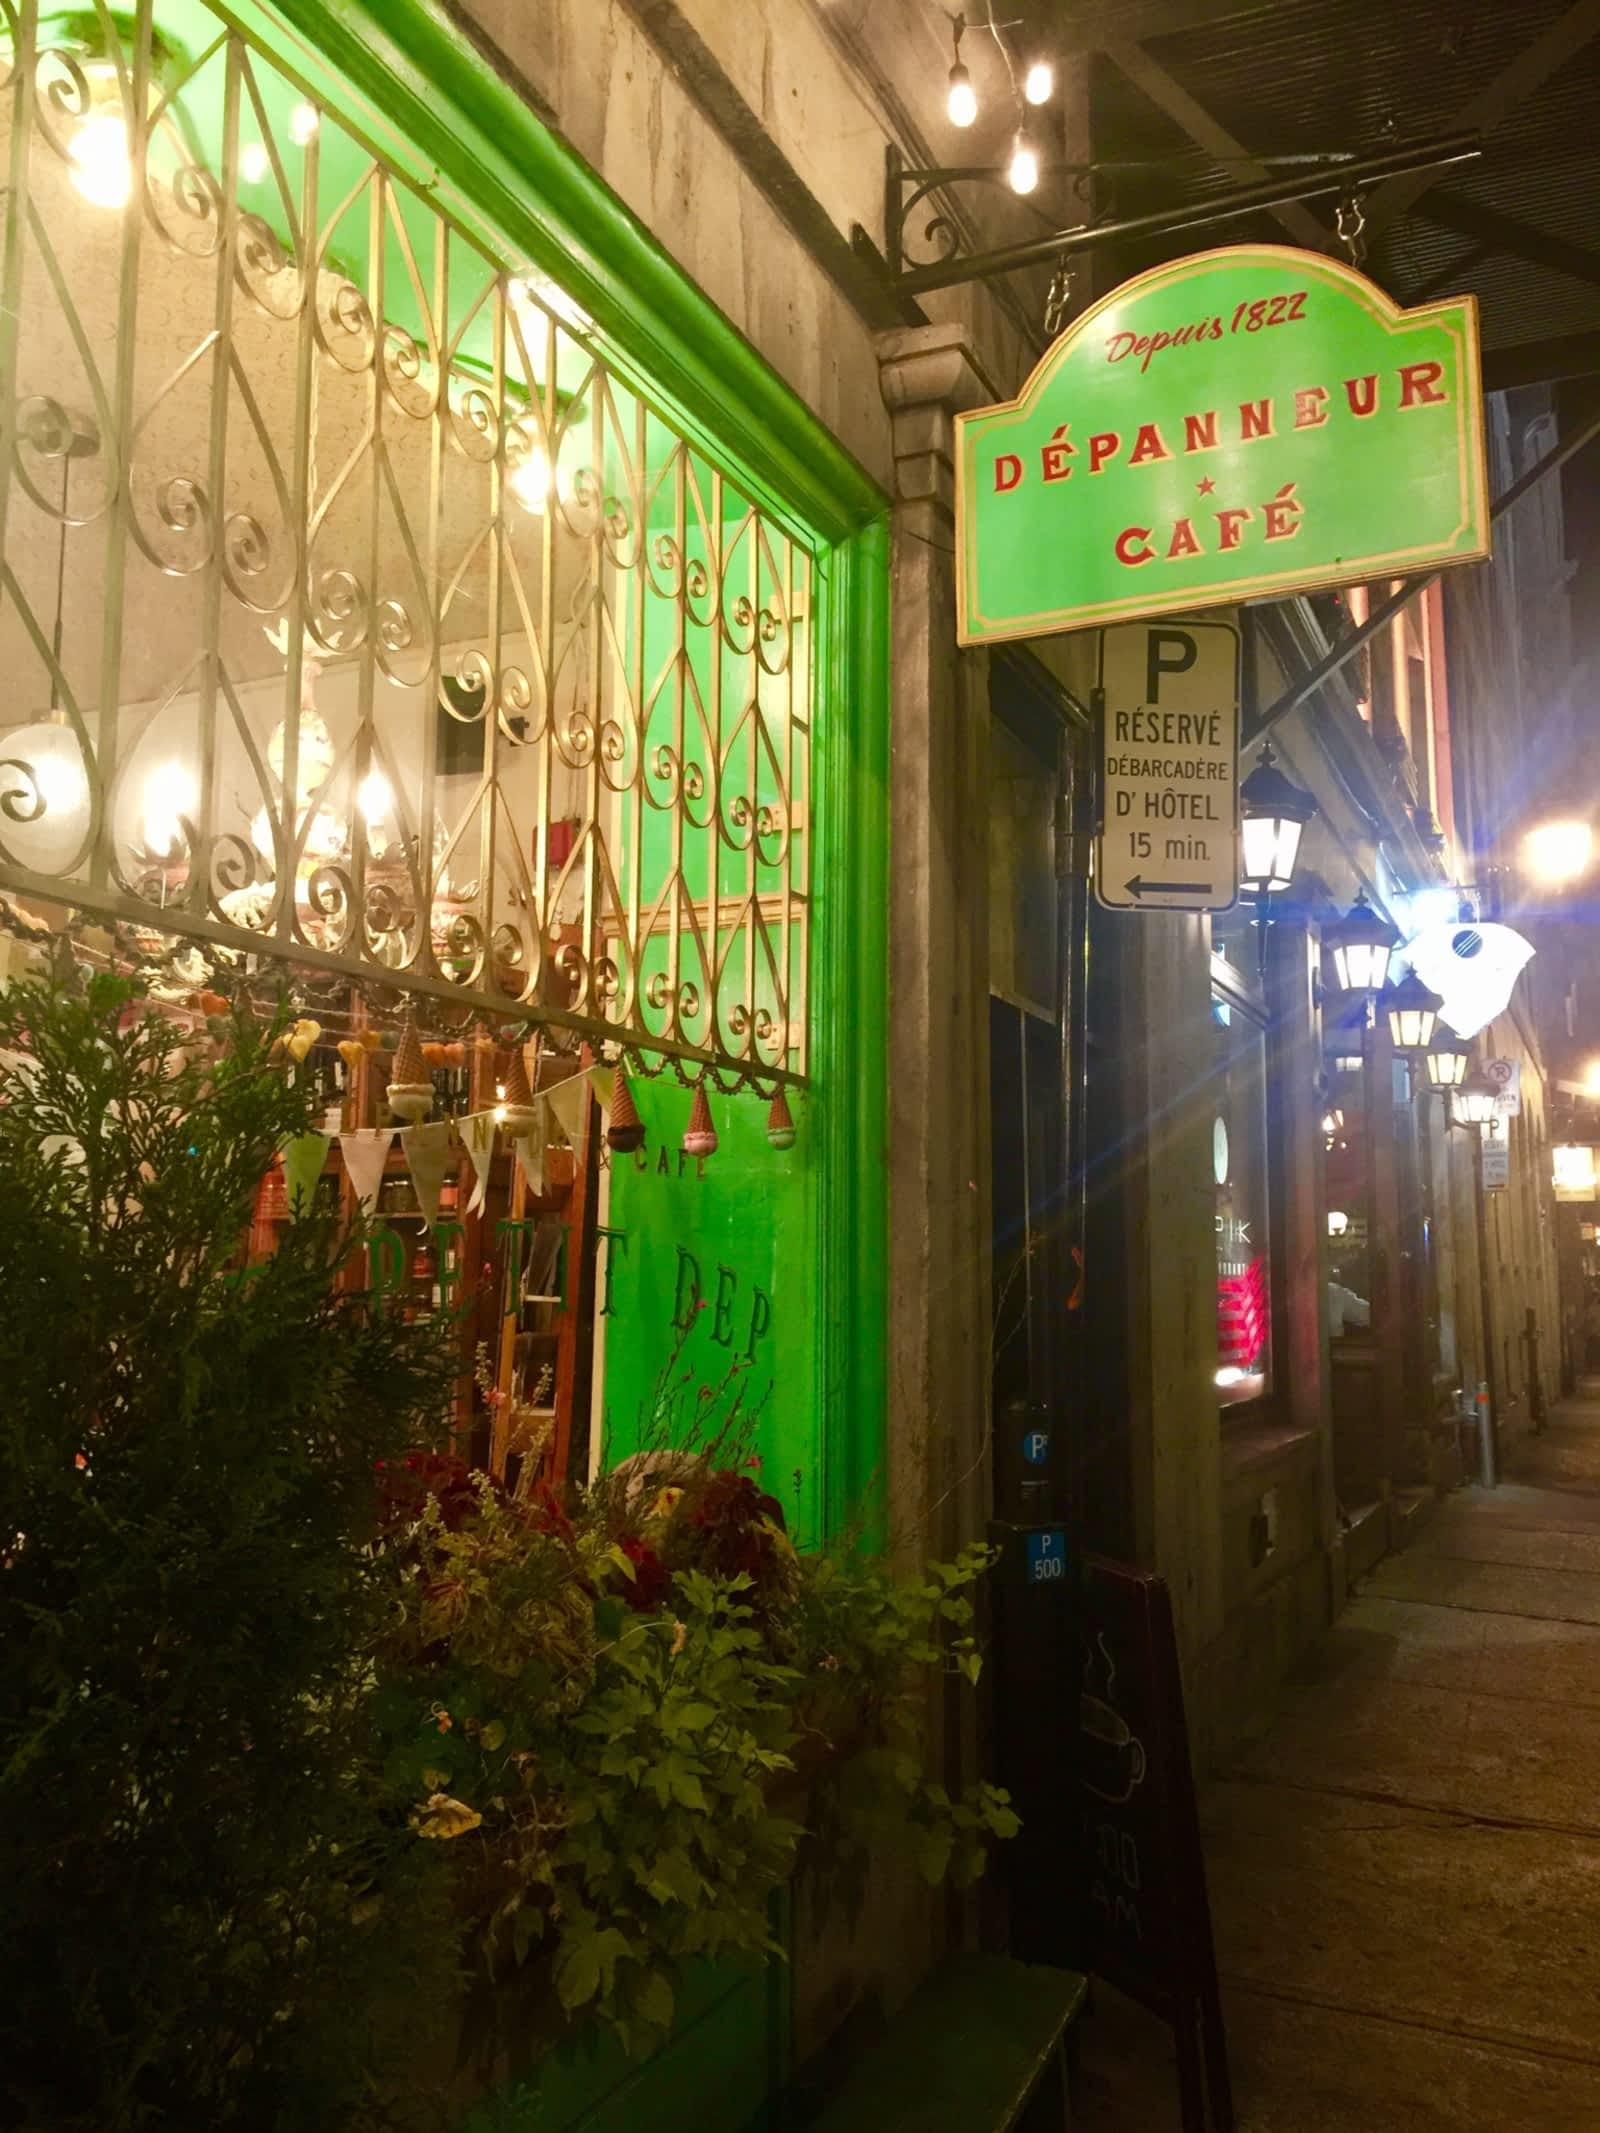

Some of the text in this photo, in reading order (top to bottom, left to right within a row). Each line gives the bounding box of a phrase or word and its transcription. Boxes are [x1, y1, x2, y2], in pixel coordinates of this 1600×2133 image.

[1105, 292, 1307, 373] Depuis 1822
[994, 361, 1447, 493] DÉPANNEUR
[1115, 483, 1303, 566] CAFÉ
[1146, 629, 1198, 704] P
[1115, 708, 1221, 746] RÉSERVÉ
[1144, 788, 1219, 820] HÔTEL
[1129, 832, 1151, 858] 15
[1041, 1535, 1051, 1554] P
[1035, 1557, 1061, 1580] 500
